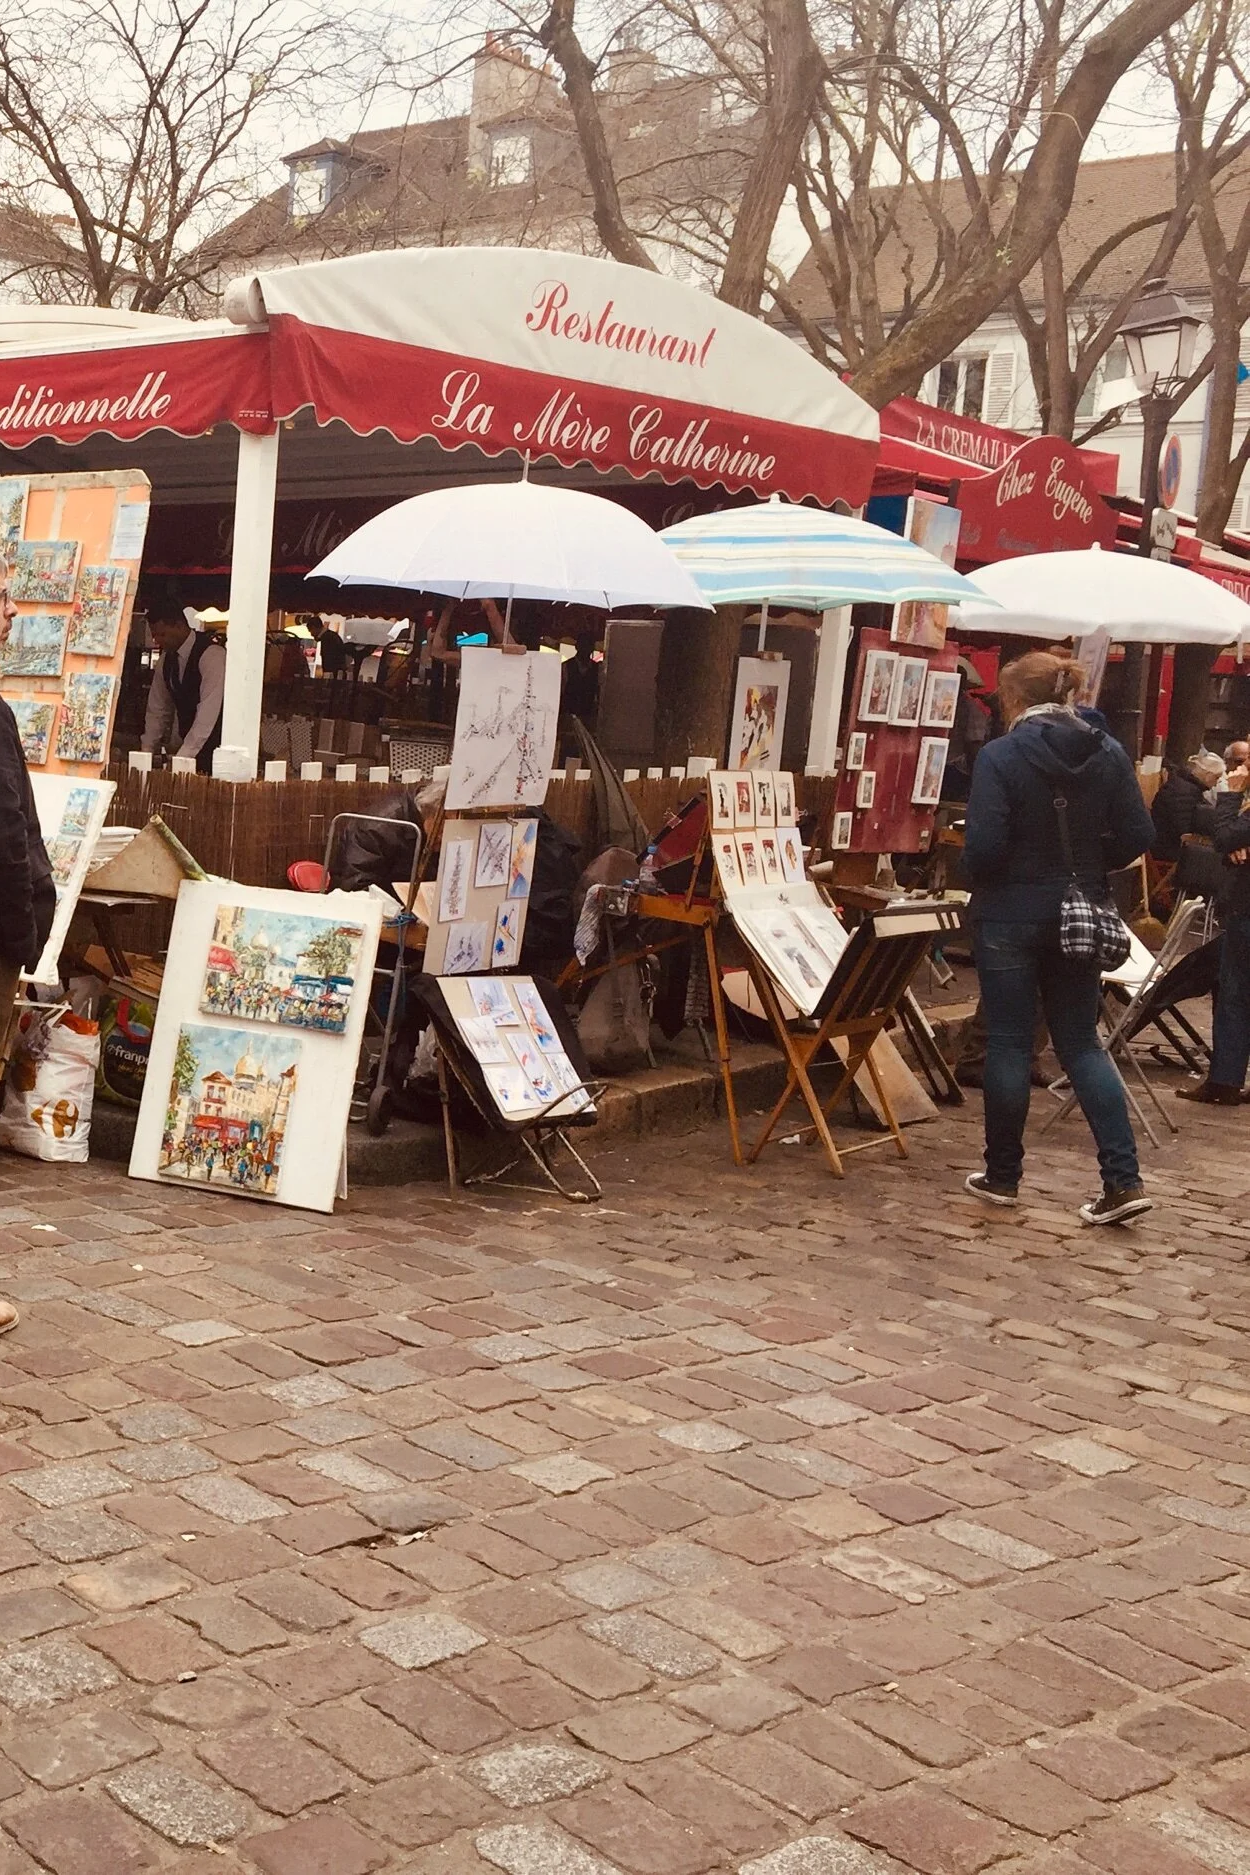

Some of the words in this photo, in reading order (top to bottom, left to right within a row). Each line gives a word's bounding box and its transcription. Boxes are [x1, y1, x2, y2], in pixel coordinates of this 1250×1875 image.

[525, 279, 718, 369] Restaurant
[431, 369, 495, 436] La
[513, 388, 612, 454] Mère
[628, 404, 776, 481] Catherine
[916, 415, 936, 449] LA
[996, 458, 1037, 508] Chez
[114, 1044, 150, 1066] franpr
